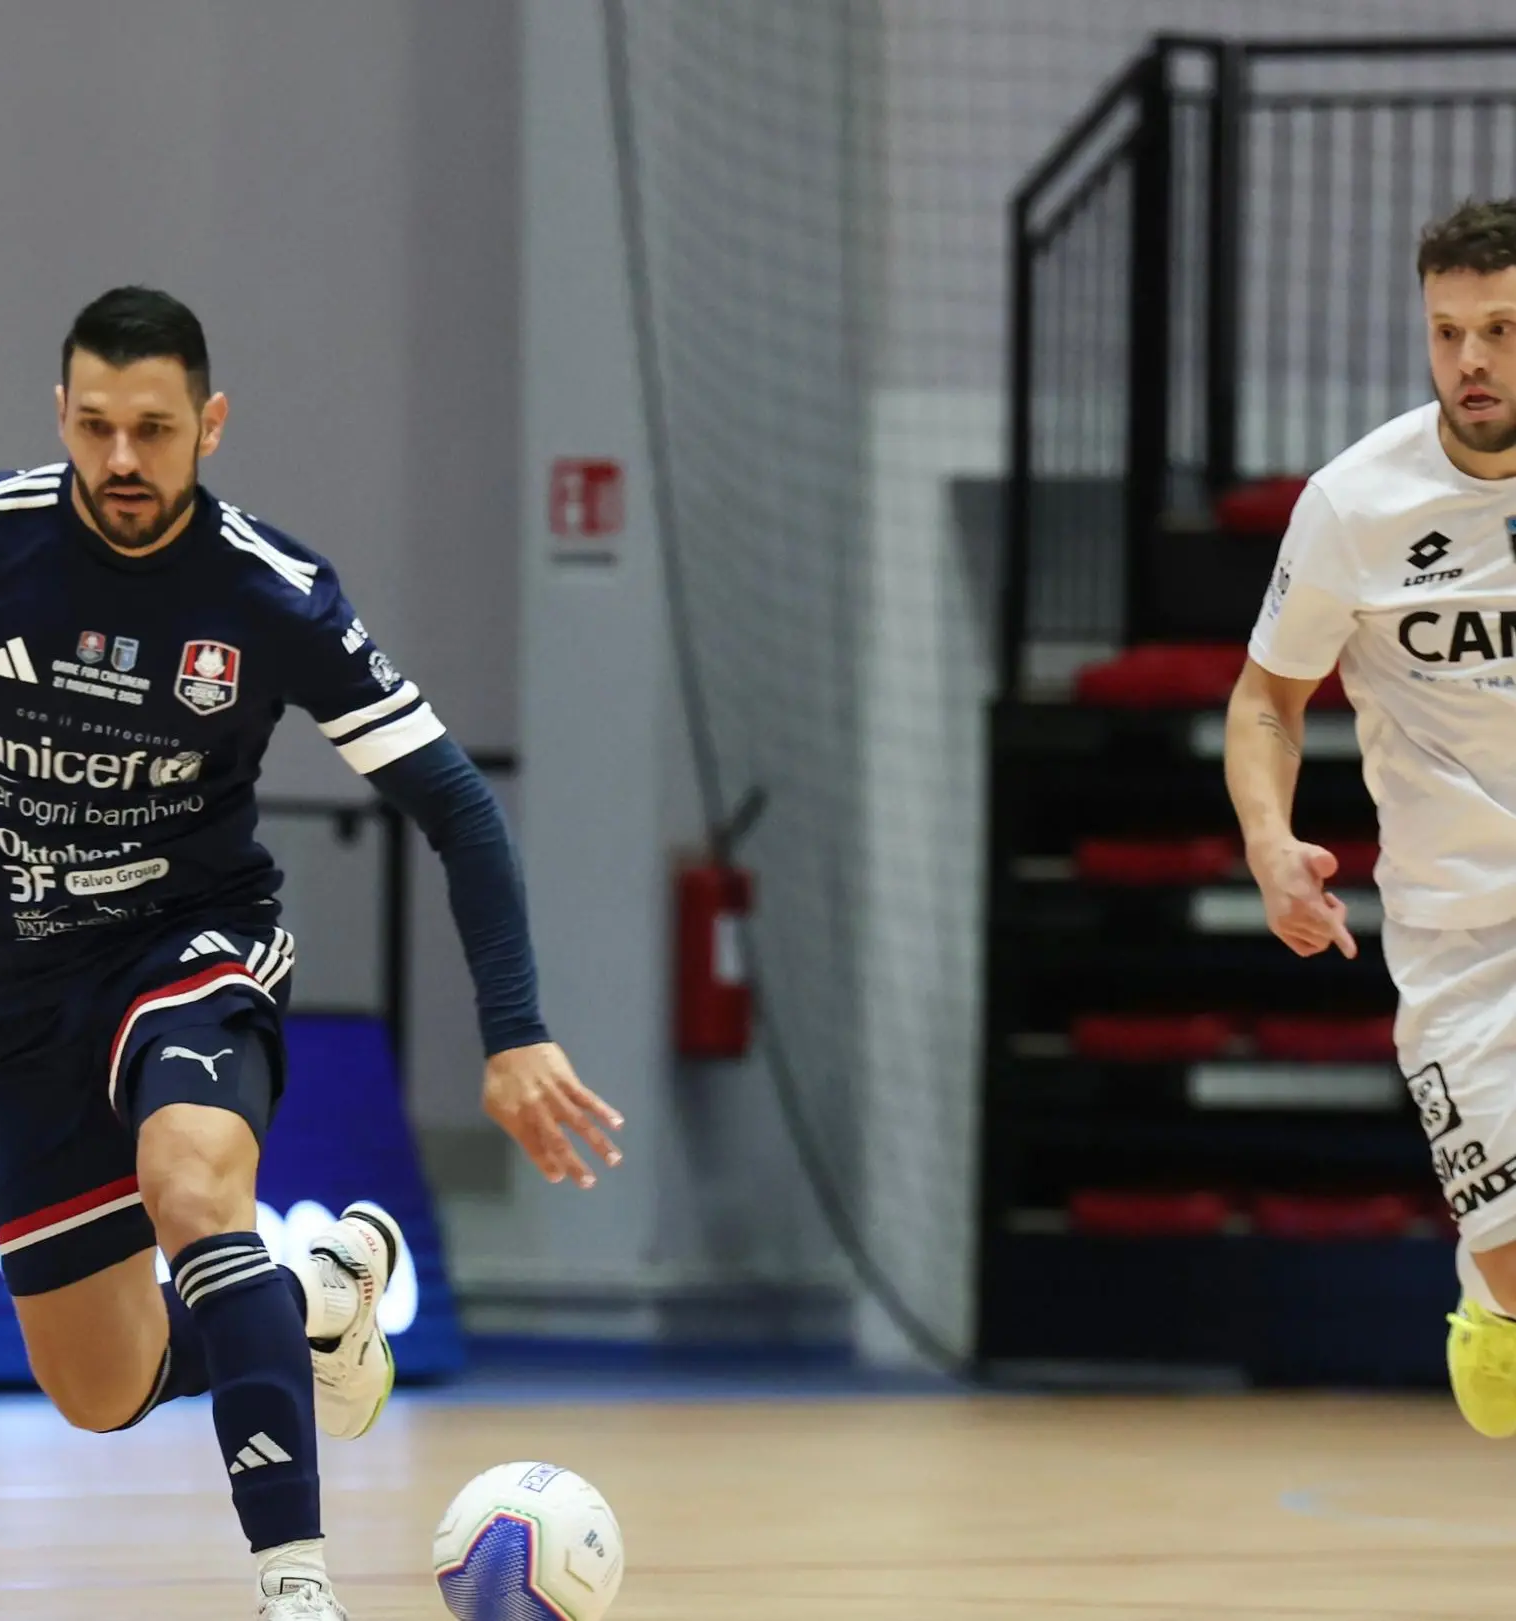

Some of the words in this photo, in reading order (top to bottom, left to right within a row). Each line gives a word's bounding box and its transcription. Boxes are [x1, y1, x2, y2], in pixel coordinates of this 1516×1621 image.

[1403, 567, 1464, 588] LOTTO
[16, 706, 49, 722] con
[58, 714, 72, 727] il
[81, 720, 182, 748] patrocinio
[18, 796, 78, 826] ogni
[84, 794, 204, 827] bambino
[2, 864, 57, 904] 3F
[72, 872, 113, 889] Falvo
[116, 862, 162, 883] Group
